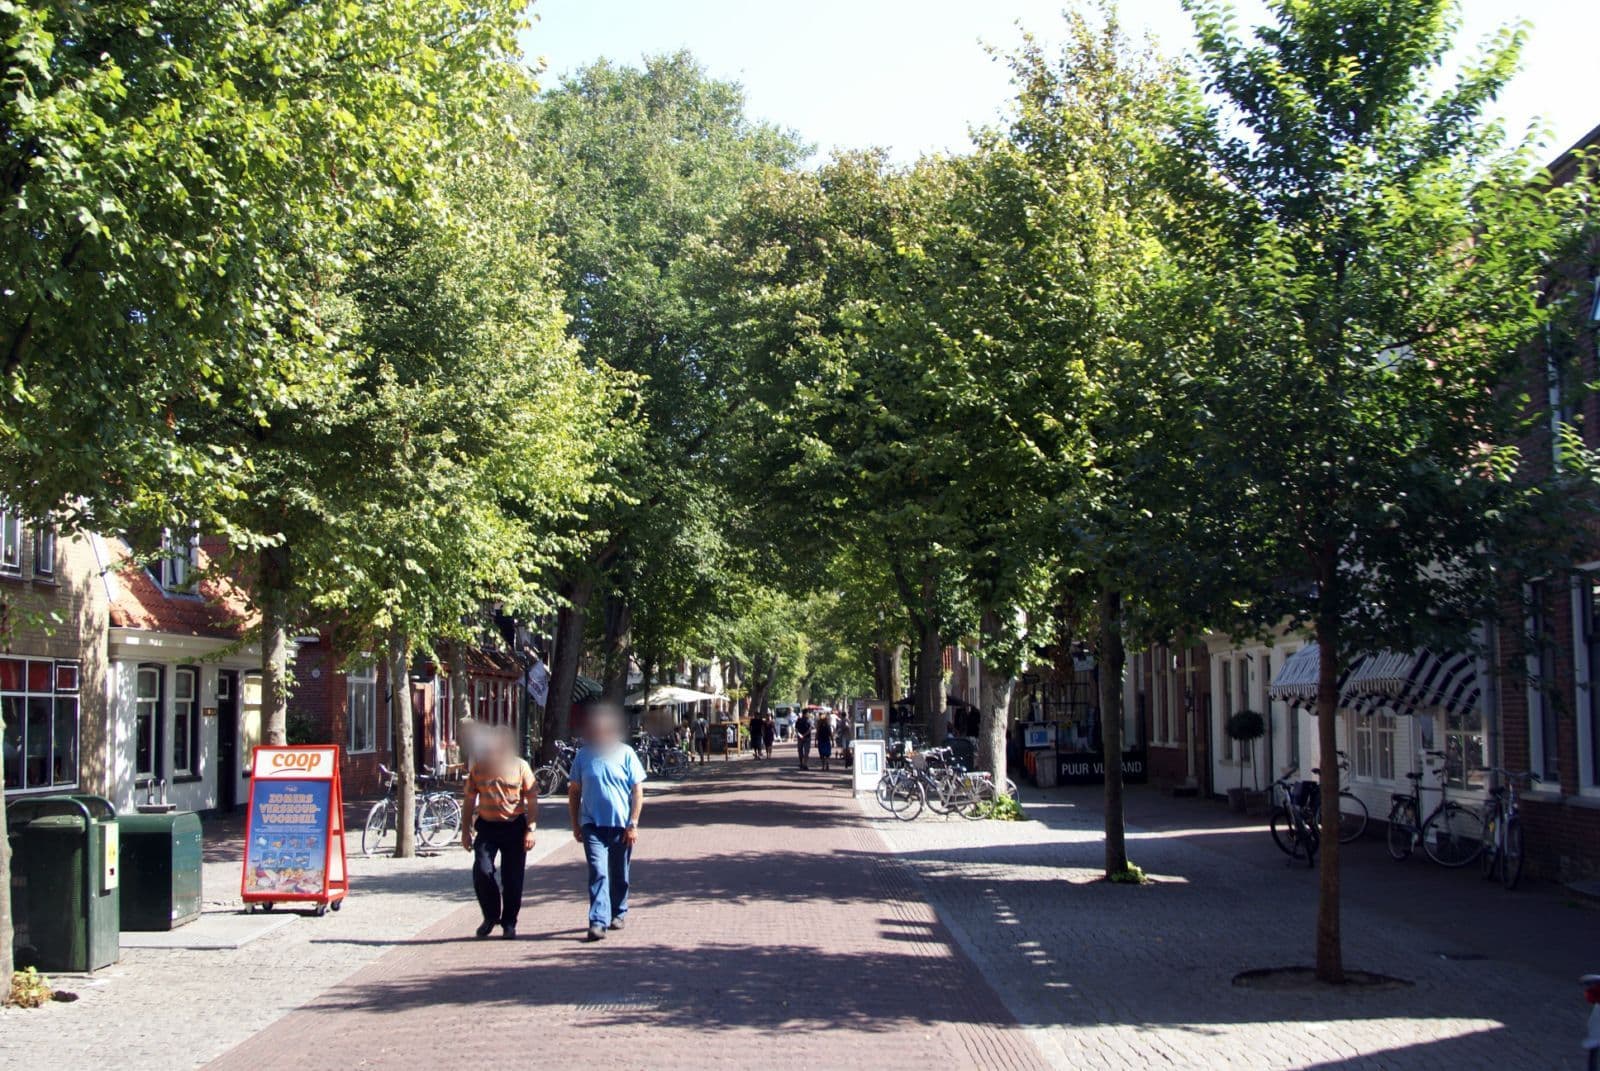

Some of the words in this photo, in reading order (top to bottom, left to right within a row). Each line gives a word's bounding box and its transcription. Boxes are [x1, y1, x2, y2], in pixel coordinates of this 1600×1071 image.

[272, 752, 321, 772] coop
[1061, 763, 1088, 775] PUUR
[262, 813, 317, 824] VOORDEEL
